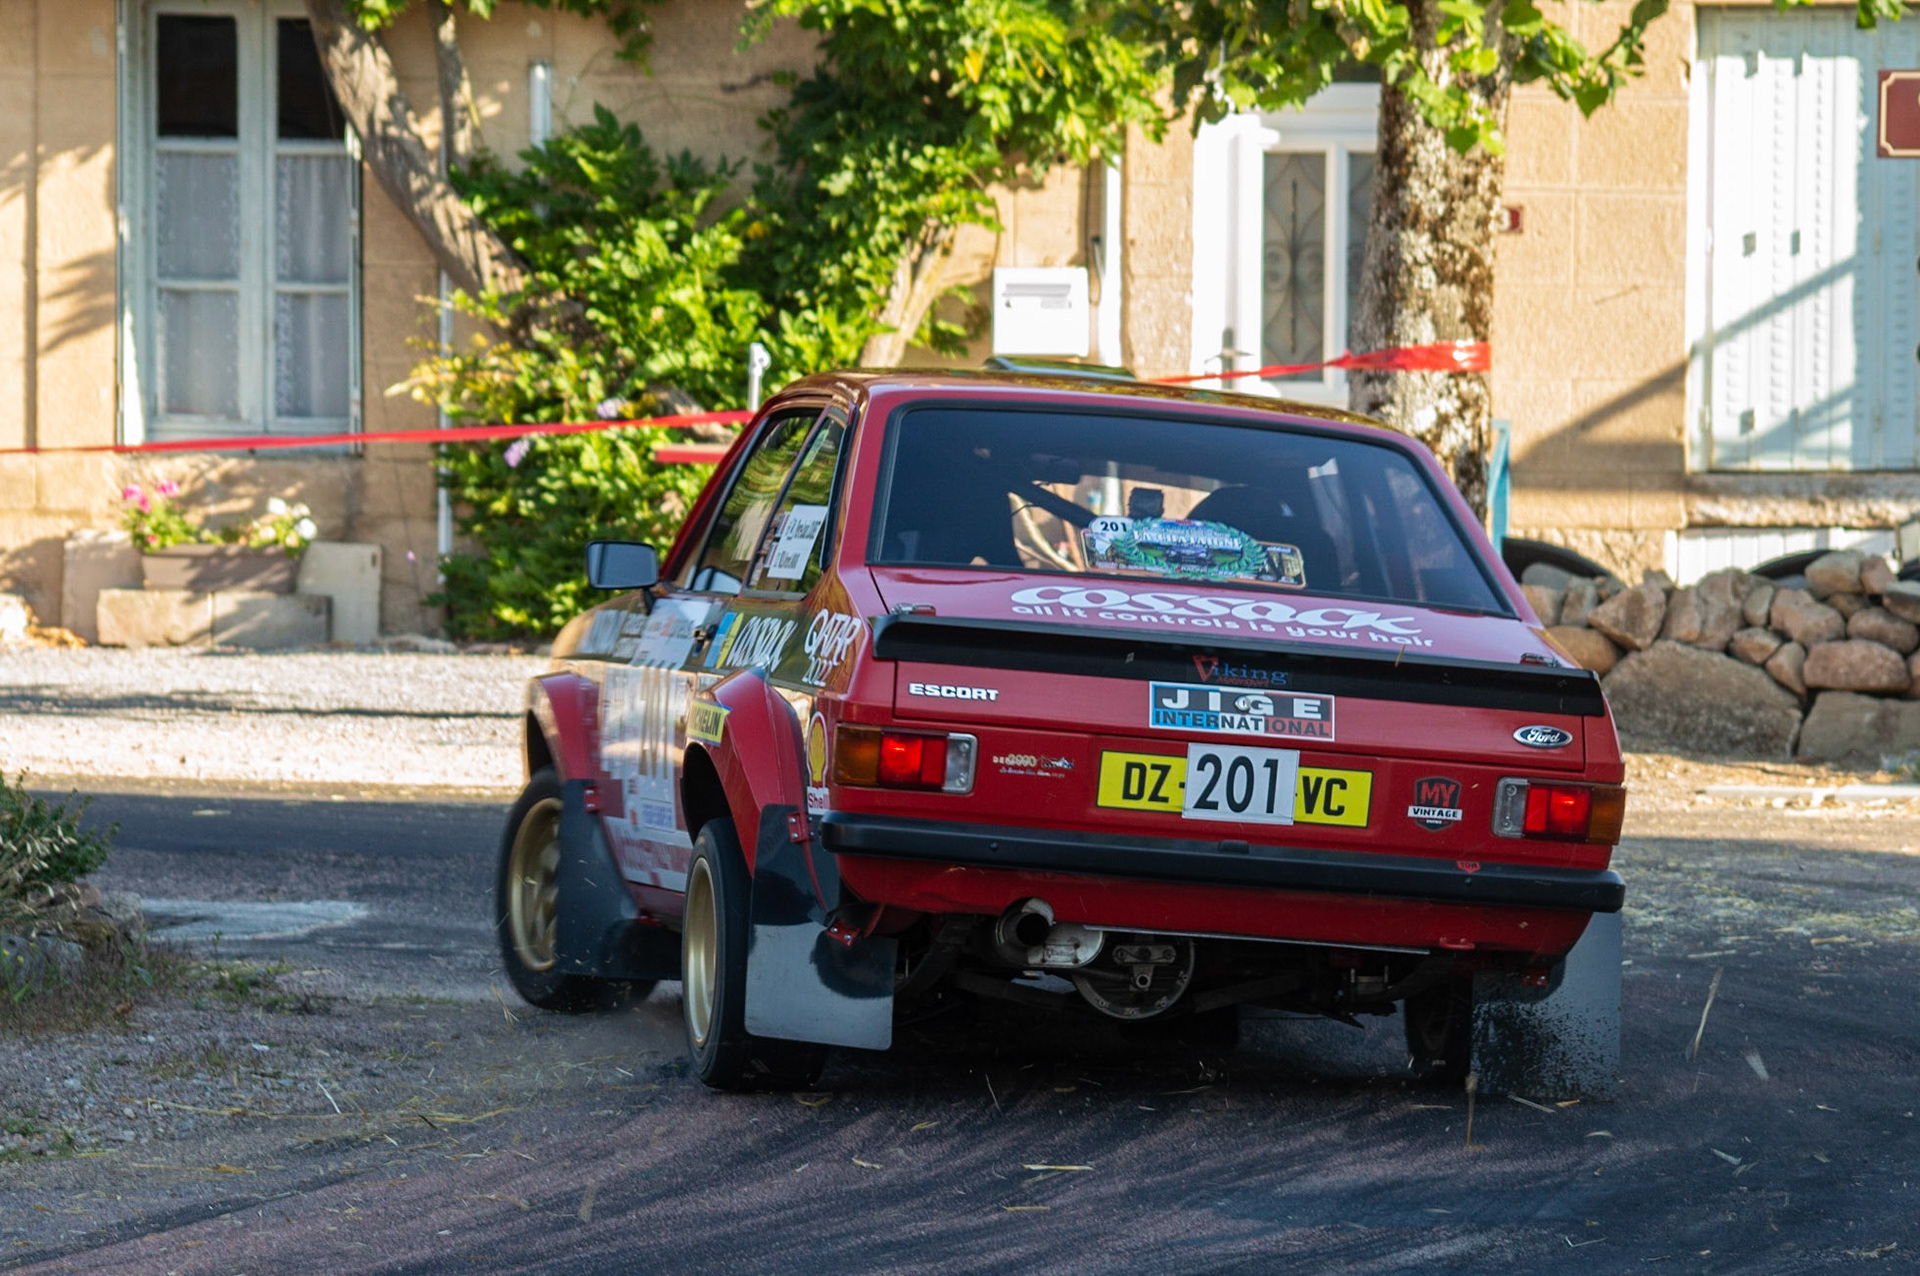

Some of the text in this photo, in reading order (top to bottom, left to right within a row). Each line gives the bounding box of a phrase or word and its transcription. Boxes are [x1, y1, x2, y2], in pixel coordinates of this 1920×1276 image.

[1100, 521, 1128, 533] 201
[1011, 604, 1434, 647] all it controls is your hair
[1192, 654, 1289, 686] Viking
[908, 682, 999, 701] ESCORT
[1161, 688, 1322, 720] JIGE
[1155, 710, 1330, 737] INTERNATIONAL
[1526, 728, 1561, 743] Ford
[1192, 753, 1280, 814] 201
[1420, 781, 1456, 808] MY
[1412, 807, 1459, 818] VINTAGE
